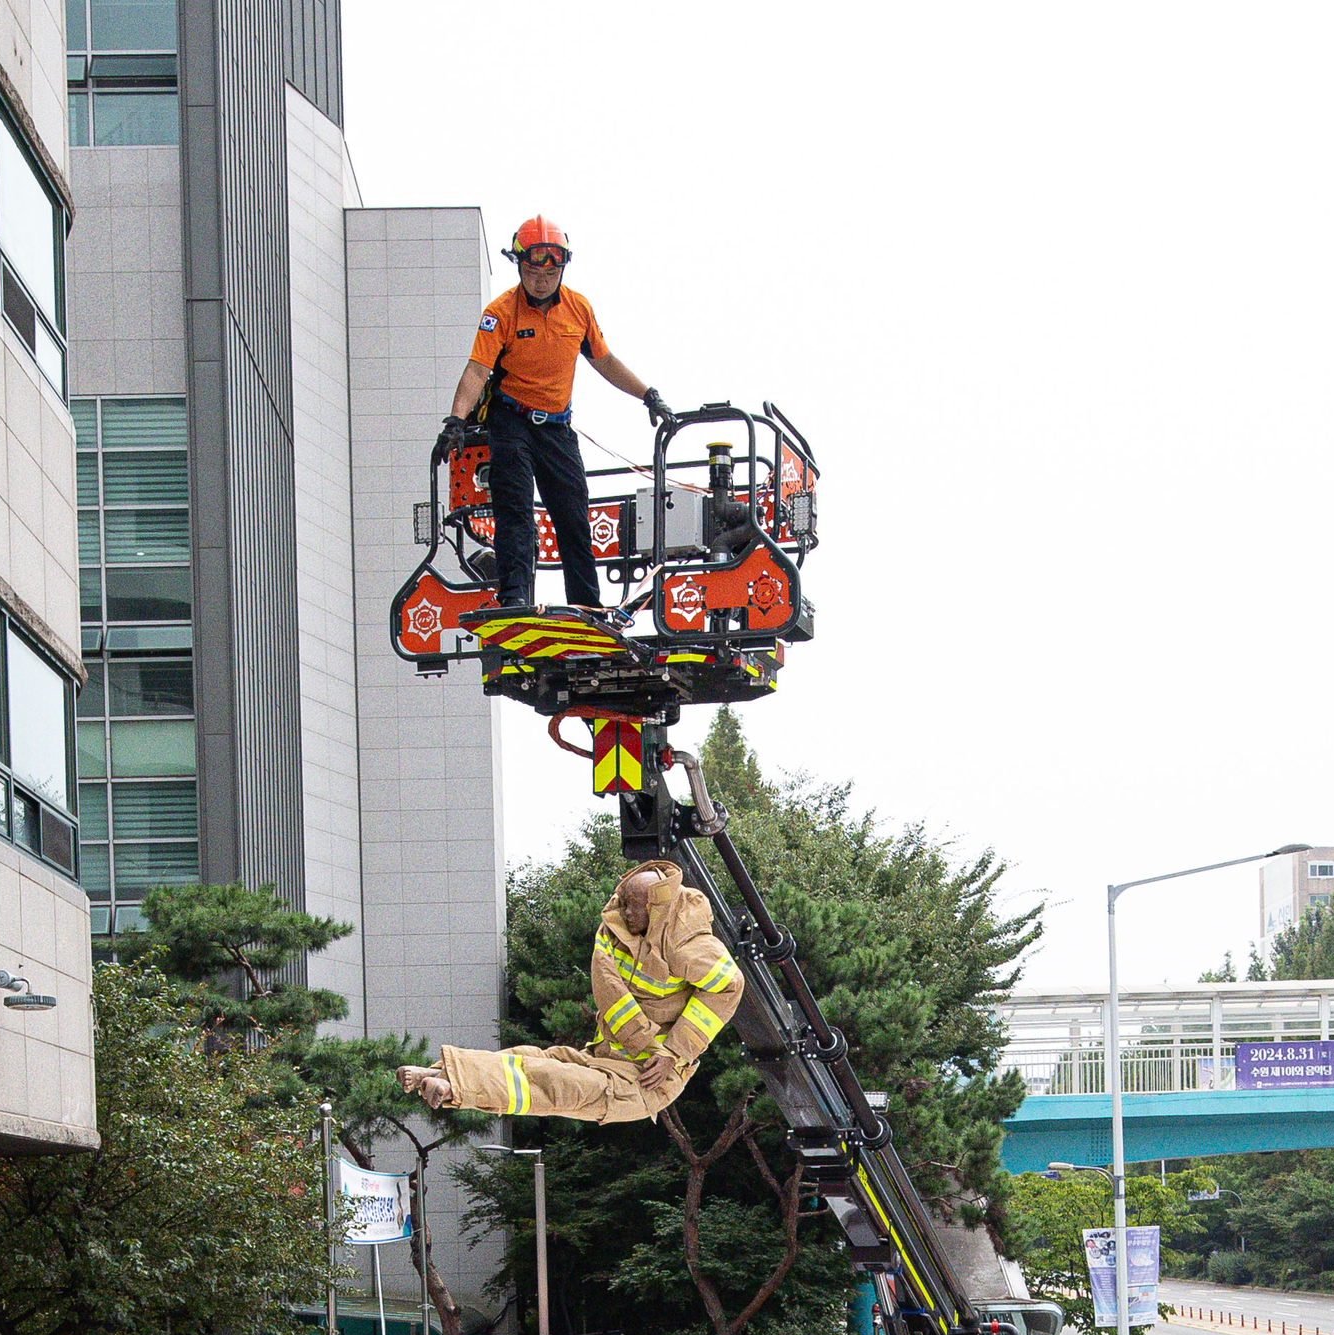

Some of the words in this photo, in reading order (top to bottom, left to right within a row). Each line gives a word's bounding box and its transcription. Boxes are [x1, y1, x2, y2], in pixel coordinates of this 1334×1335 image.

[1250, 1047, 1315, 1061] 2024.8.31
[1250, 1066, 1270, 1078] 수원
[1305, 1065, 1332, 1077] 음악당
